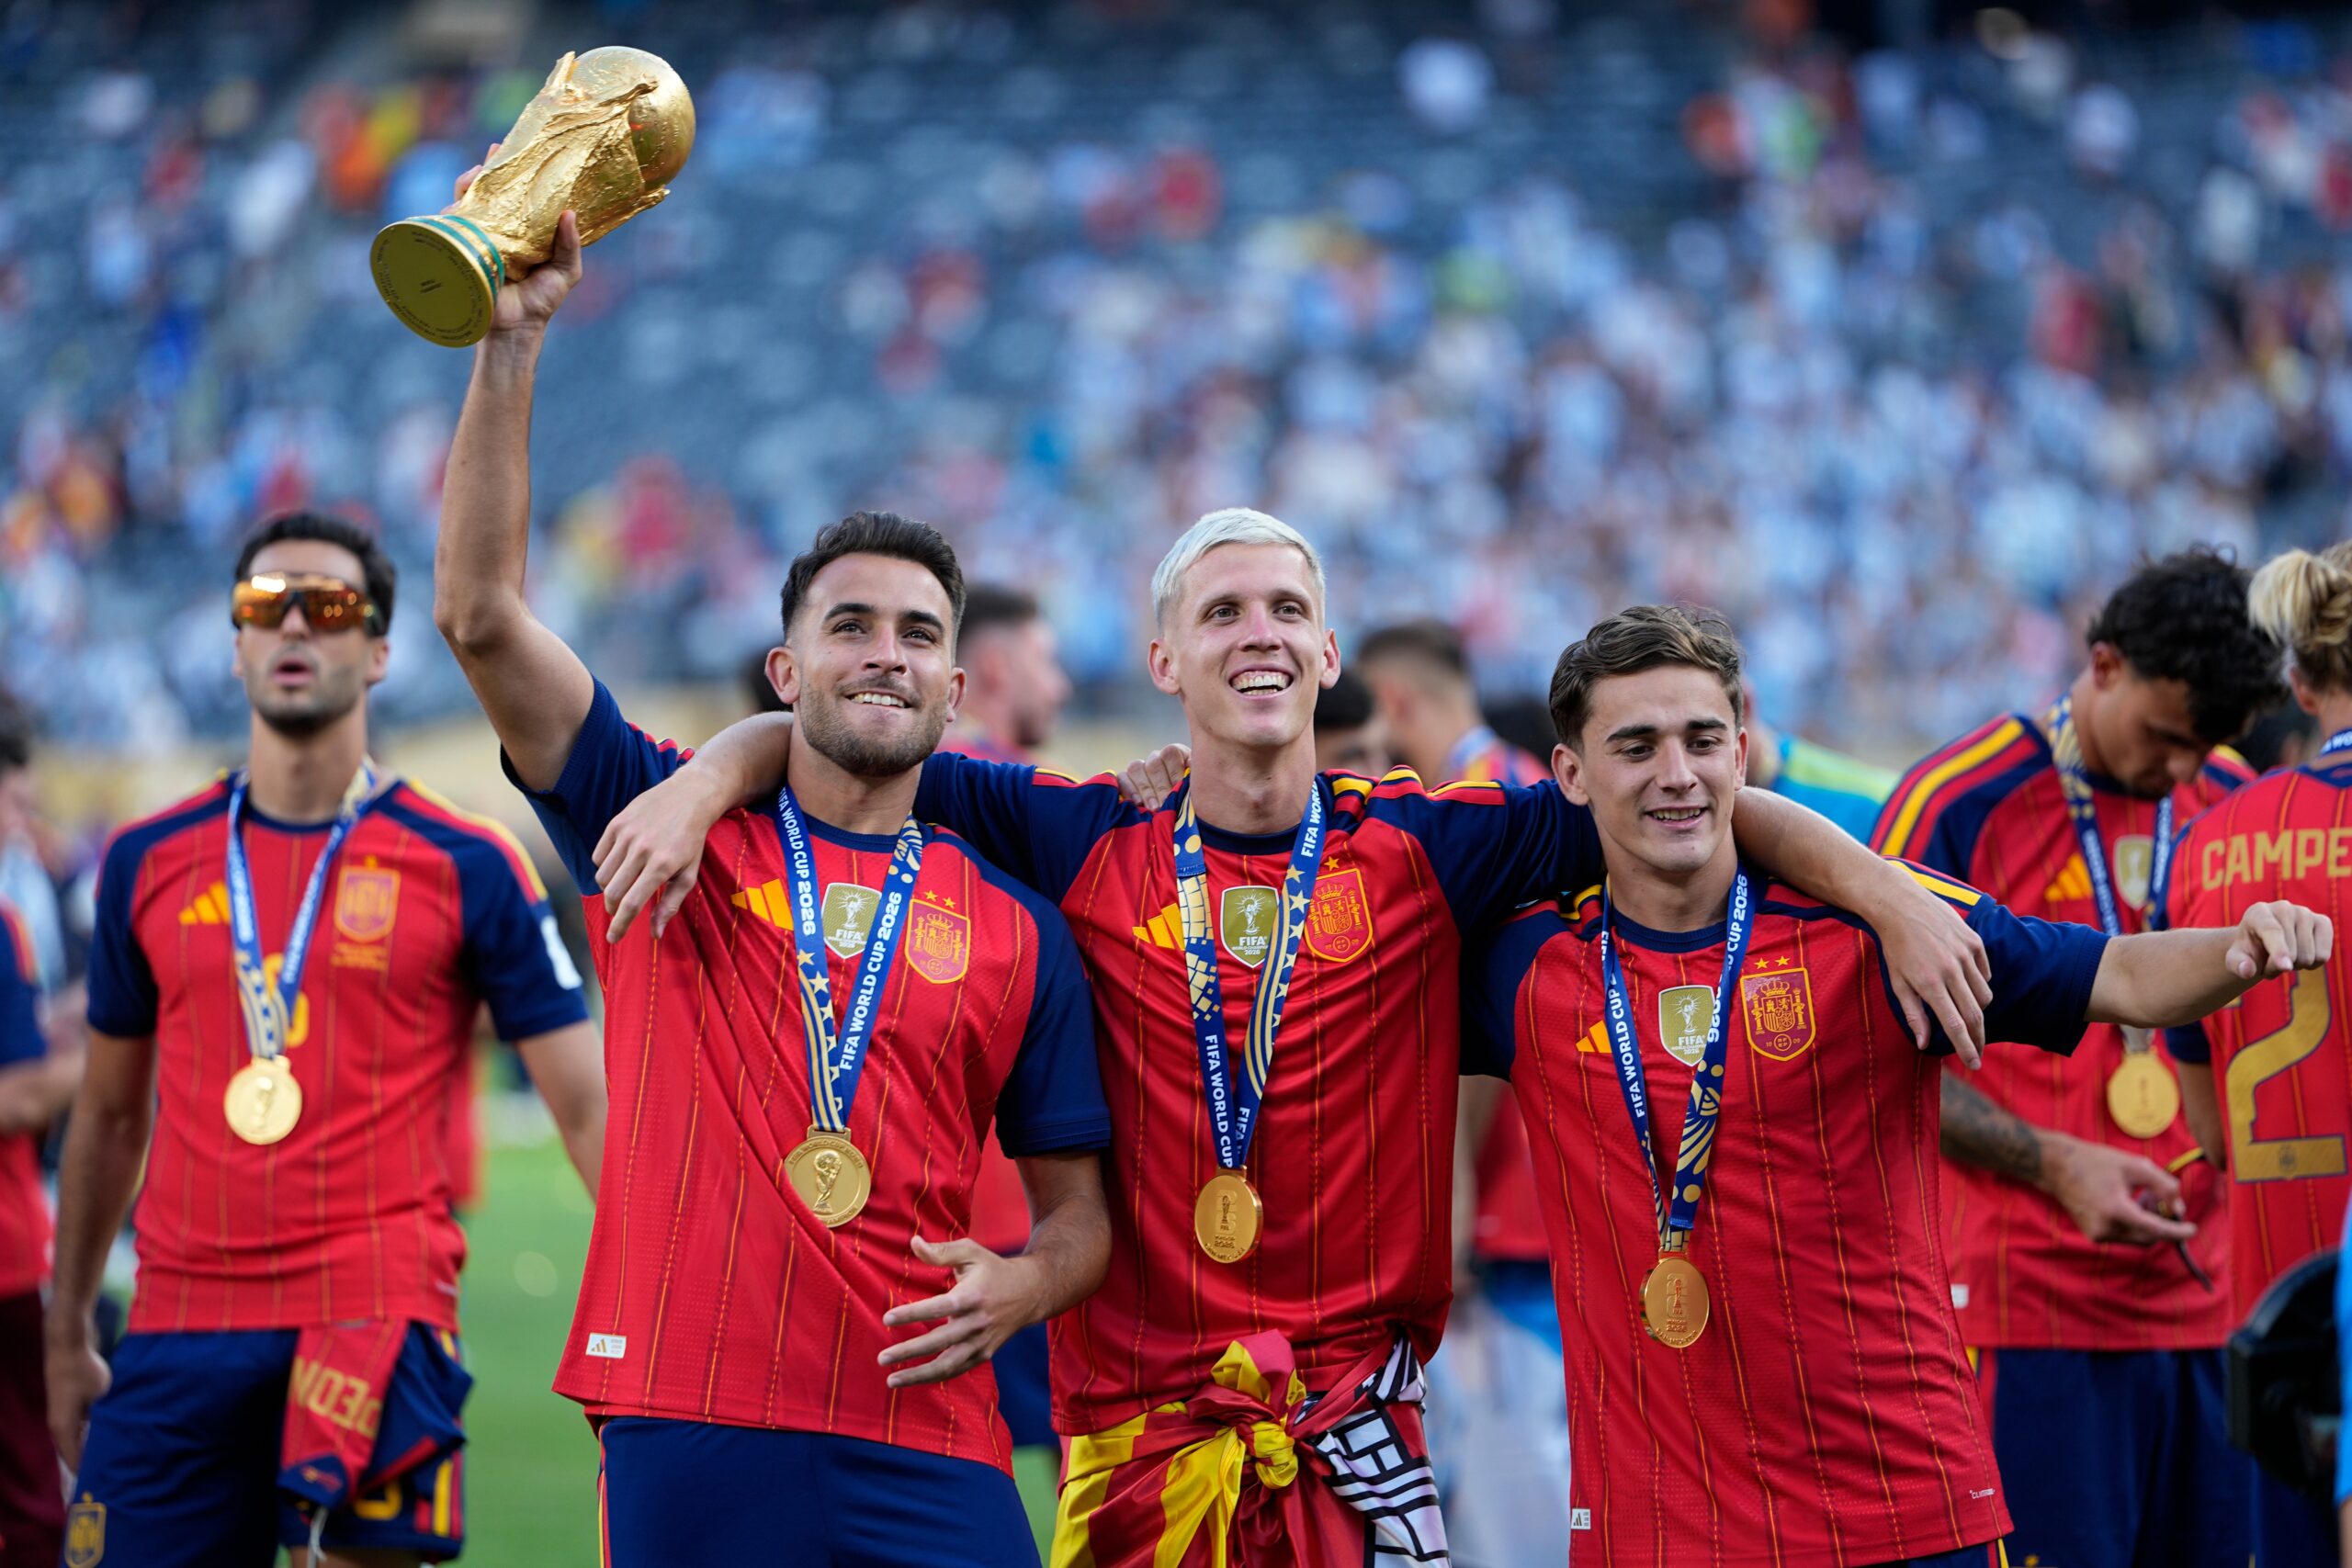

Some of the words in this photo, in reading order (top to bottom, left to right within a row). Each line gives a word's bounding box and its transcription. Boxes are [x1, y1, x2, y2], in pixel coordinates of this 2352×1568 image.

[778, 787, 788, 812] FIFA
[782, 807, 802, 850] WORLD
[1301, 828, 1318, 858] FIFA
[793, 852, 809, 879] CUP
[2202, 829, 2352, 891] CAMPE
[797, 881, 816, 936] 2026
[1733, 874, 1747, 921] 2026
[877, 892, 902, 941] 2026
[1239, 936, 1265, 946] FIFA
[1727, 921, 1742, 953] CUP
[867, 942, 887, 973] CUP
[849, 974, 876, 1036] WORLD
[1608, 988, 1624, 1020] CUP
[840, 1034, 860, 1070] FIFA
[1204, 1034, 1220, 1071] FIFA
[1614, 1021, 1636, 1082] WORLD
[1678, 1035, 1703, 1045] FIFA
[1210, 1071, 1229, 1134] WORLD
[1628, 1081, 1645, 1118] FIFA
[1235, 1106, 1250, 1141] FIFA
[1220, 1135, 1233, 1168] CUP
